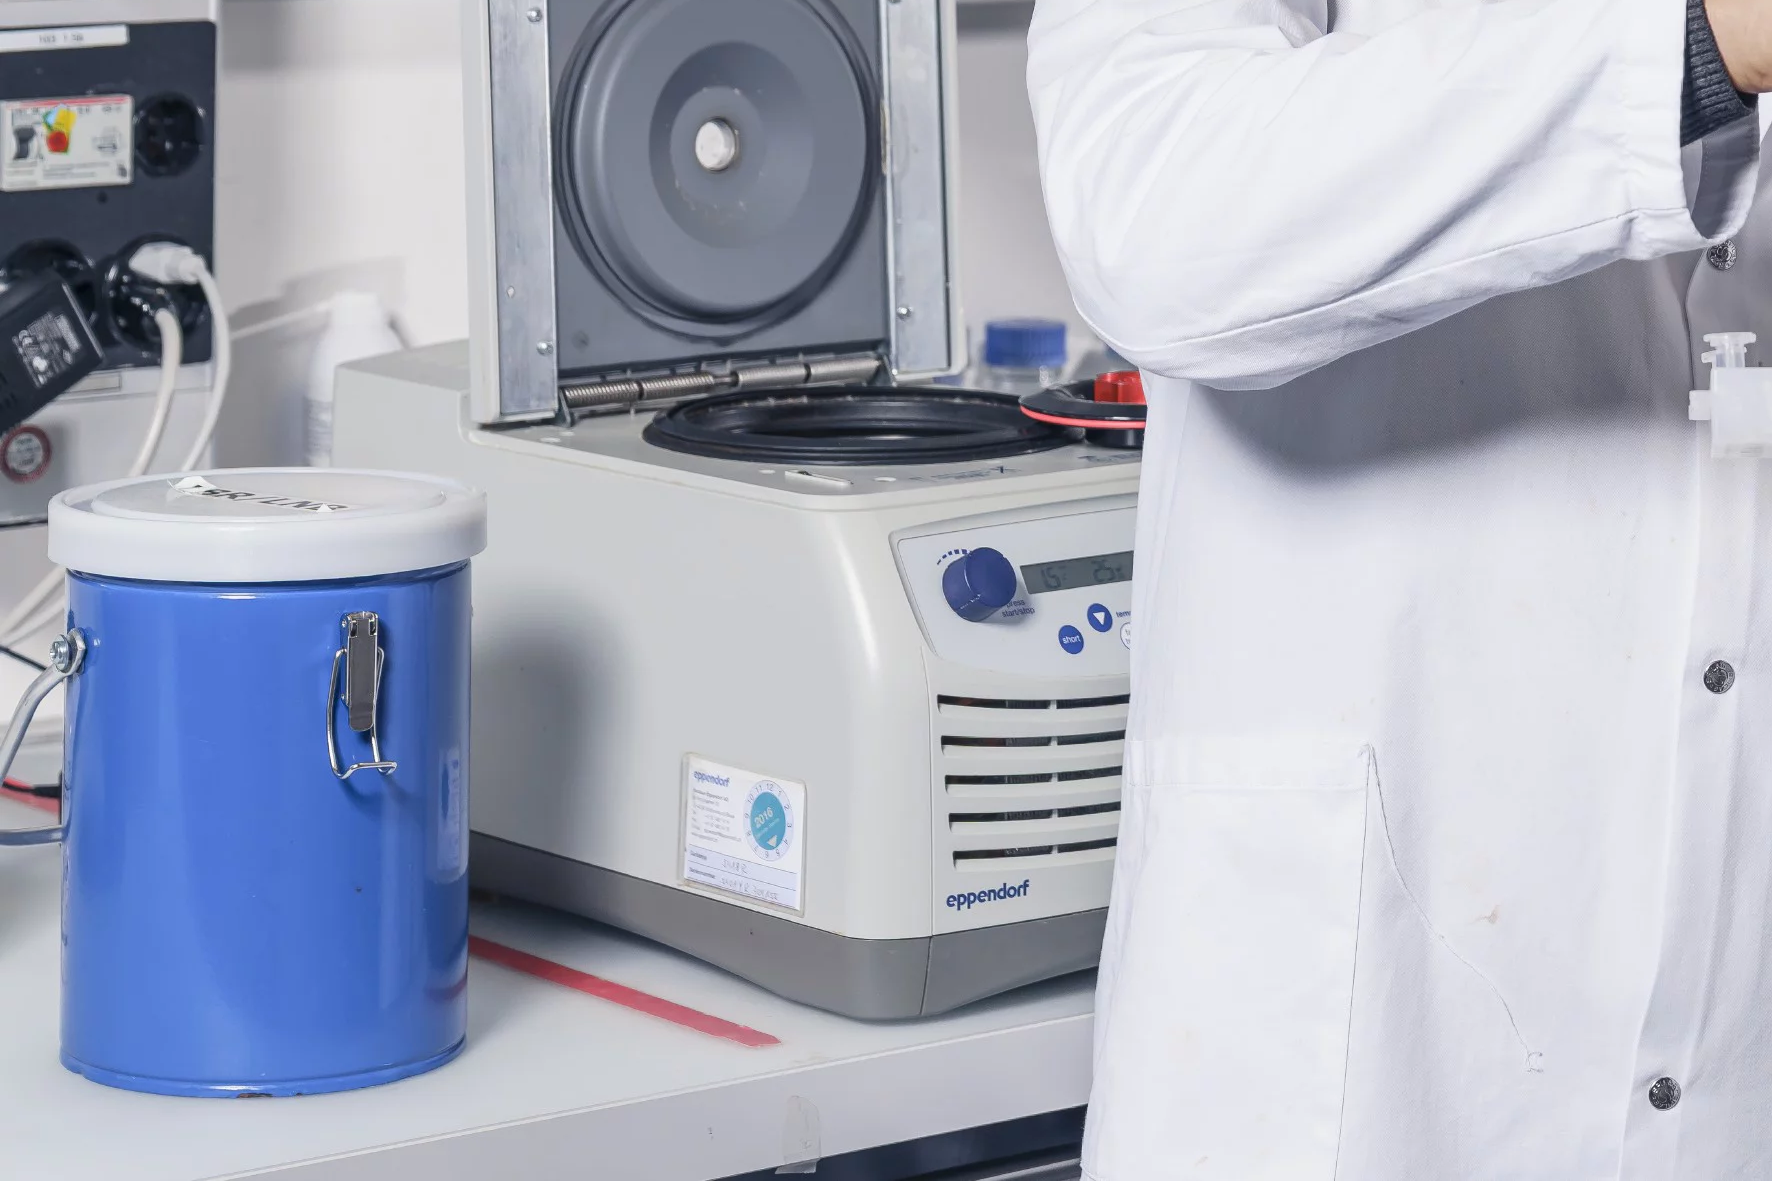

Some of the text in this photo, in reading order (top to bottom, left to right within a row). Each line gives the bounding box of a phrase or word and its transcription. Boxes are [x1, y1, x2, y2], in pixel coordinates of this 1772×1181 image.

[1002, 608, 1035, 617] start/stop
[1062, 635, 1081, 644] short
[693, 770, 731, 787] eppendorf
[754, 806, 774, 829] 2016
[946, 879, 1030, 911] eppendorf
